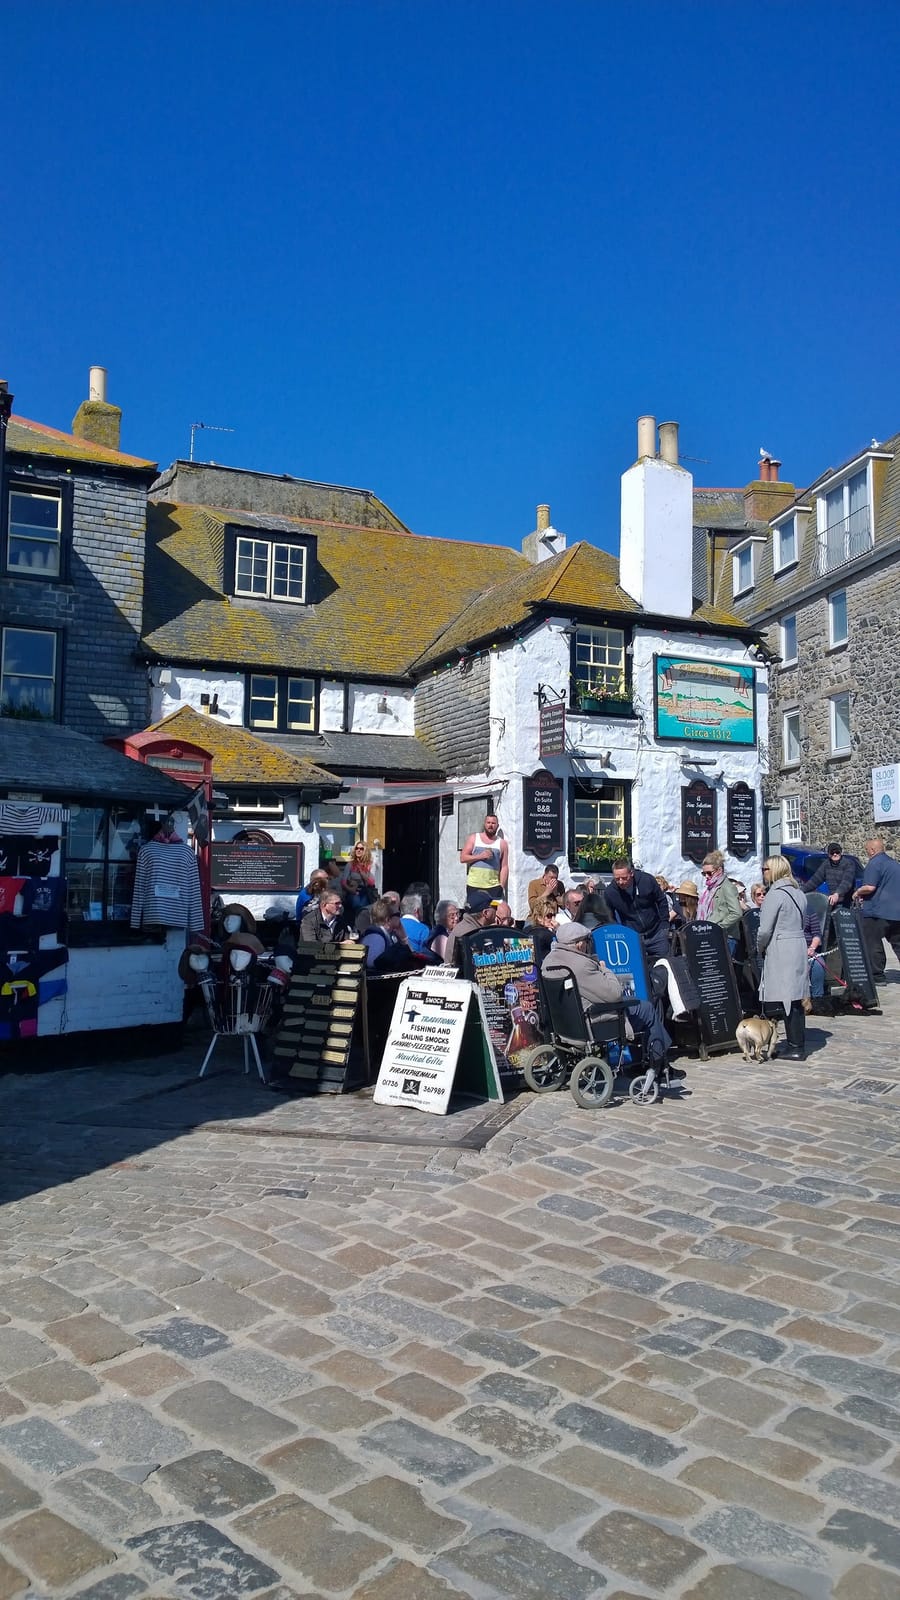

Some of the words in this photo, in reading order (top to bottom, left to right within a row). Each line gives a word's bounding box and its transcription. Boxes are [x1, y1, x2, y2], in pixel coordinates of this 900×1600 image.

[534, 790, 552, 798] Quality
[537, 805, 551, 813] B&B
[687, 815, 713, 826] ALES
[473, 953, 496, 967] Take
[496, 951, 505, 964] it
[505, 948, 533, 963] away!
[421, 1016, 457, 1026] TRADITIONAL
[410, 1024, 436, 1034] FISHING
[437, 1027, 451, 1035] AND
[401, 1033, 424, 1042] SAILING
[425, 1036, 449, 1045] SMOCKS
[395, 1052, 425, 1064] Nautical
[426, 1056, 444, 1066] Gifts
[382, 1079, 399, 1087] 01736
[423, 1086, 446, 1095] 367989
